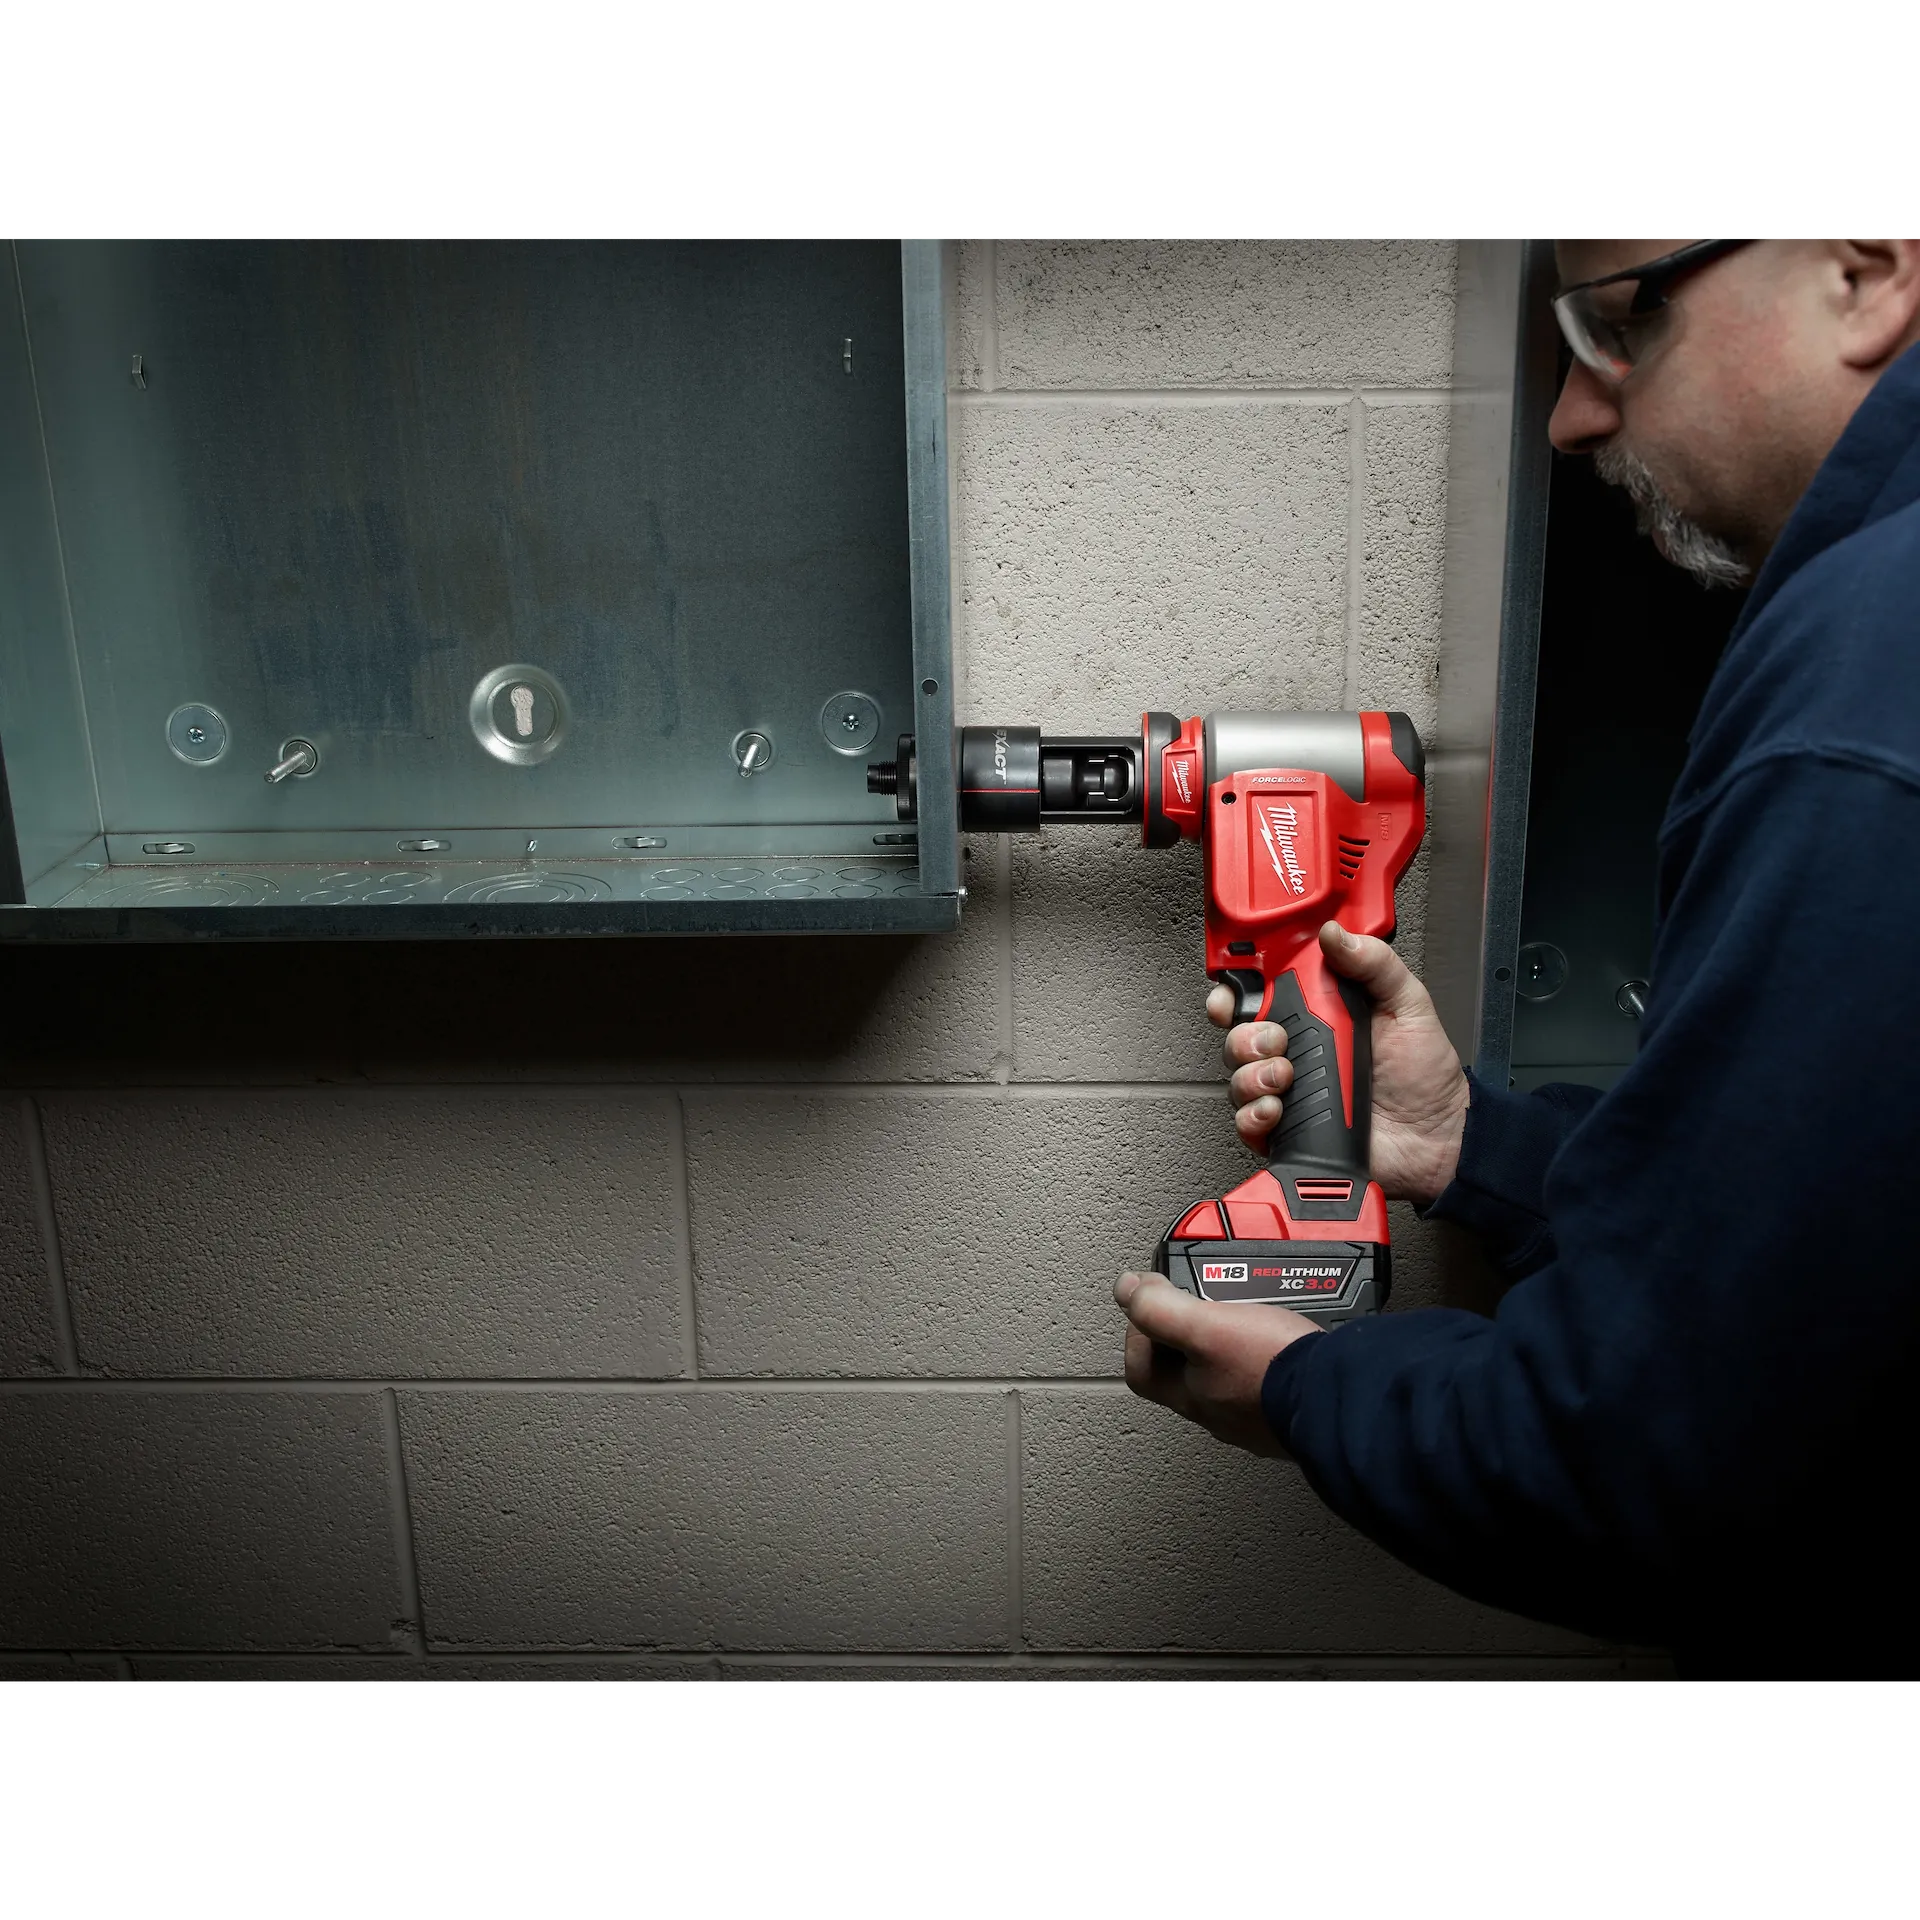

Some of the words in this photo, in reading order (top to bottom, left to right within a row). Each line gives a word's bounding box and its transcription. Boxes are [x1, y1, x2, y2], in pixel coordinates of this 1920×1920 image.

[992, 729, 1011, 781] EXACT
[1175, 760, 1192, 803] Milwaukee
[1266, 801, 1307, 895] Milwaukee
[1205, 1266, 1245, 1279] M18
[1252, 1267, 1342, 1277] REDLITHIUM
[1279, 1278, 1337, 1290] XC3.0
